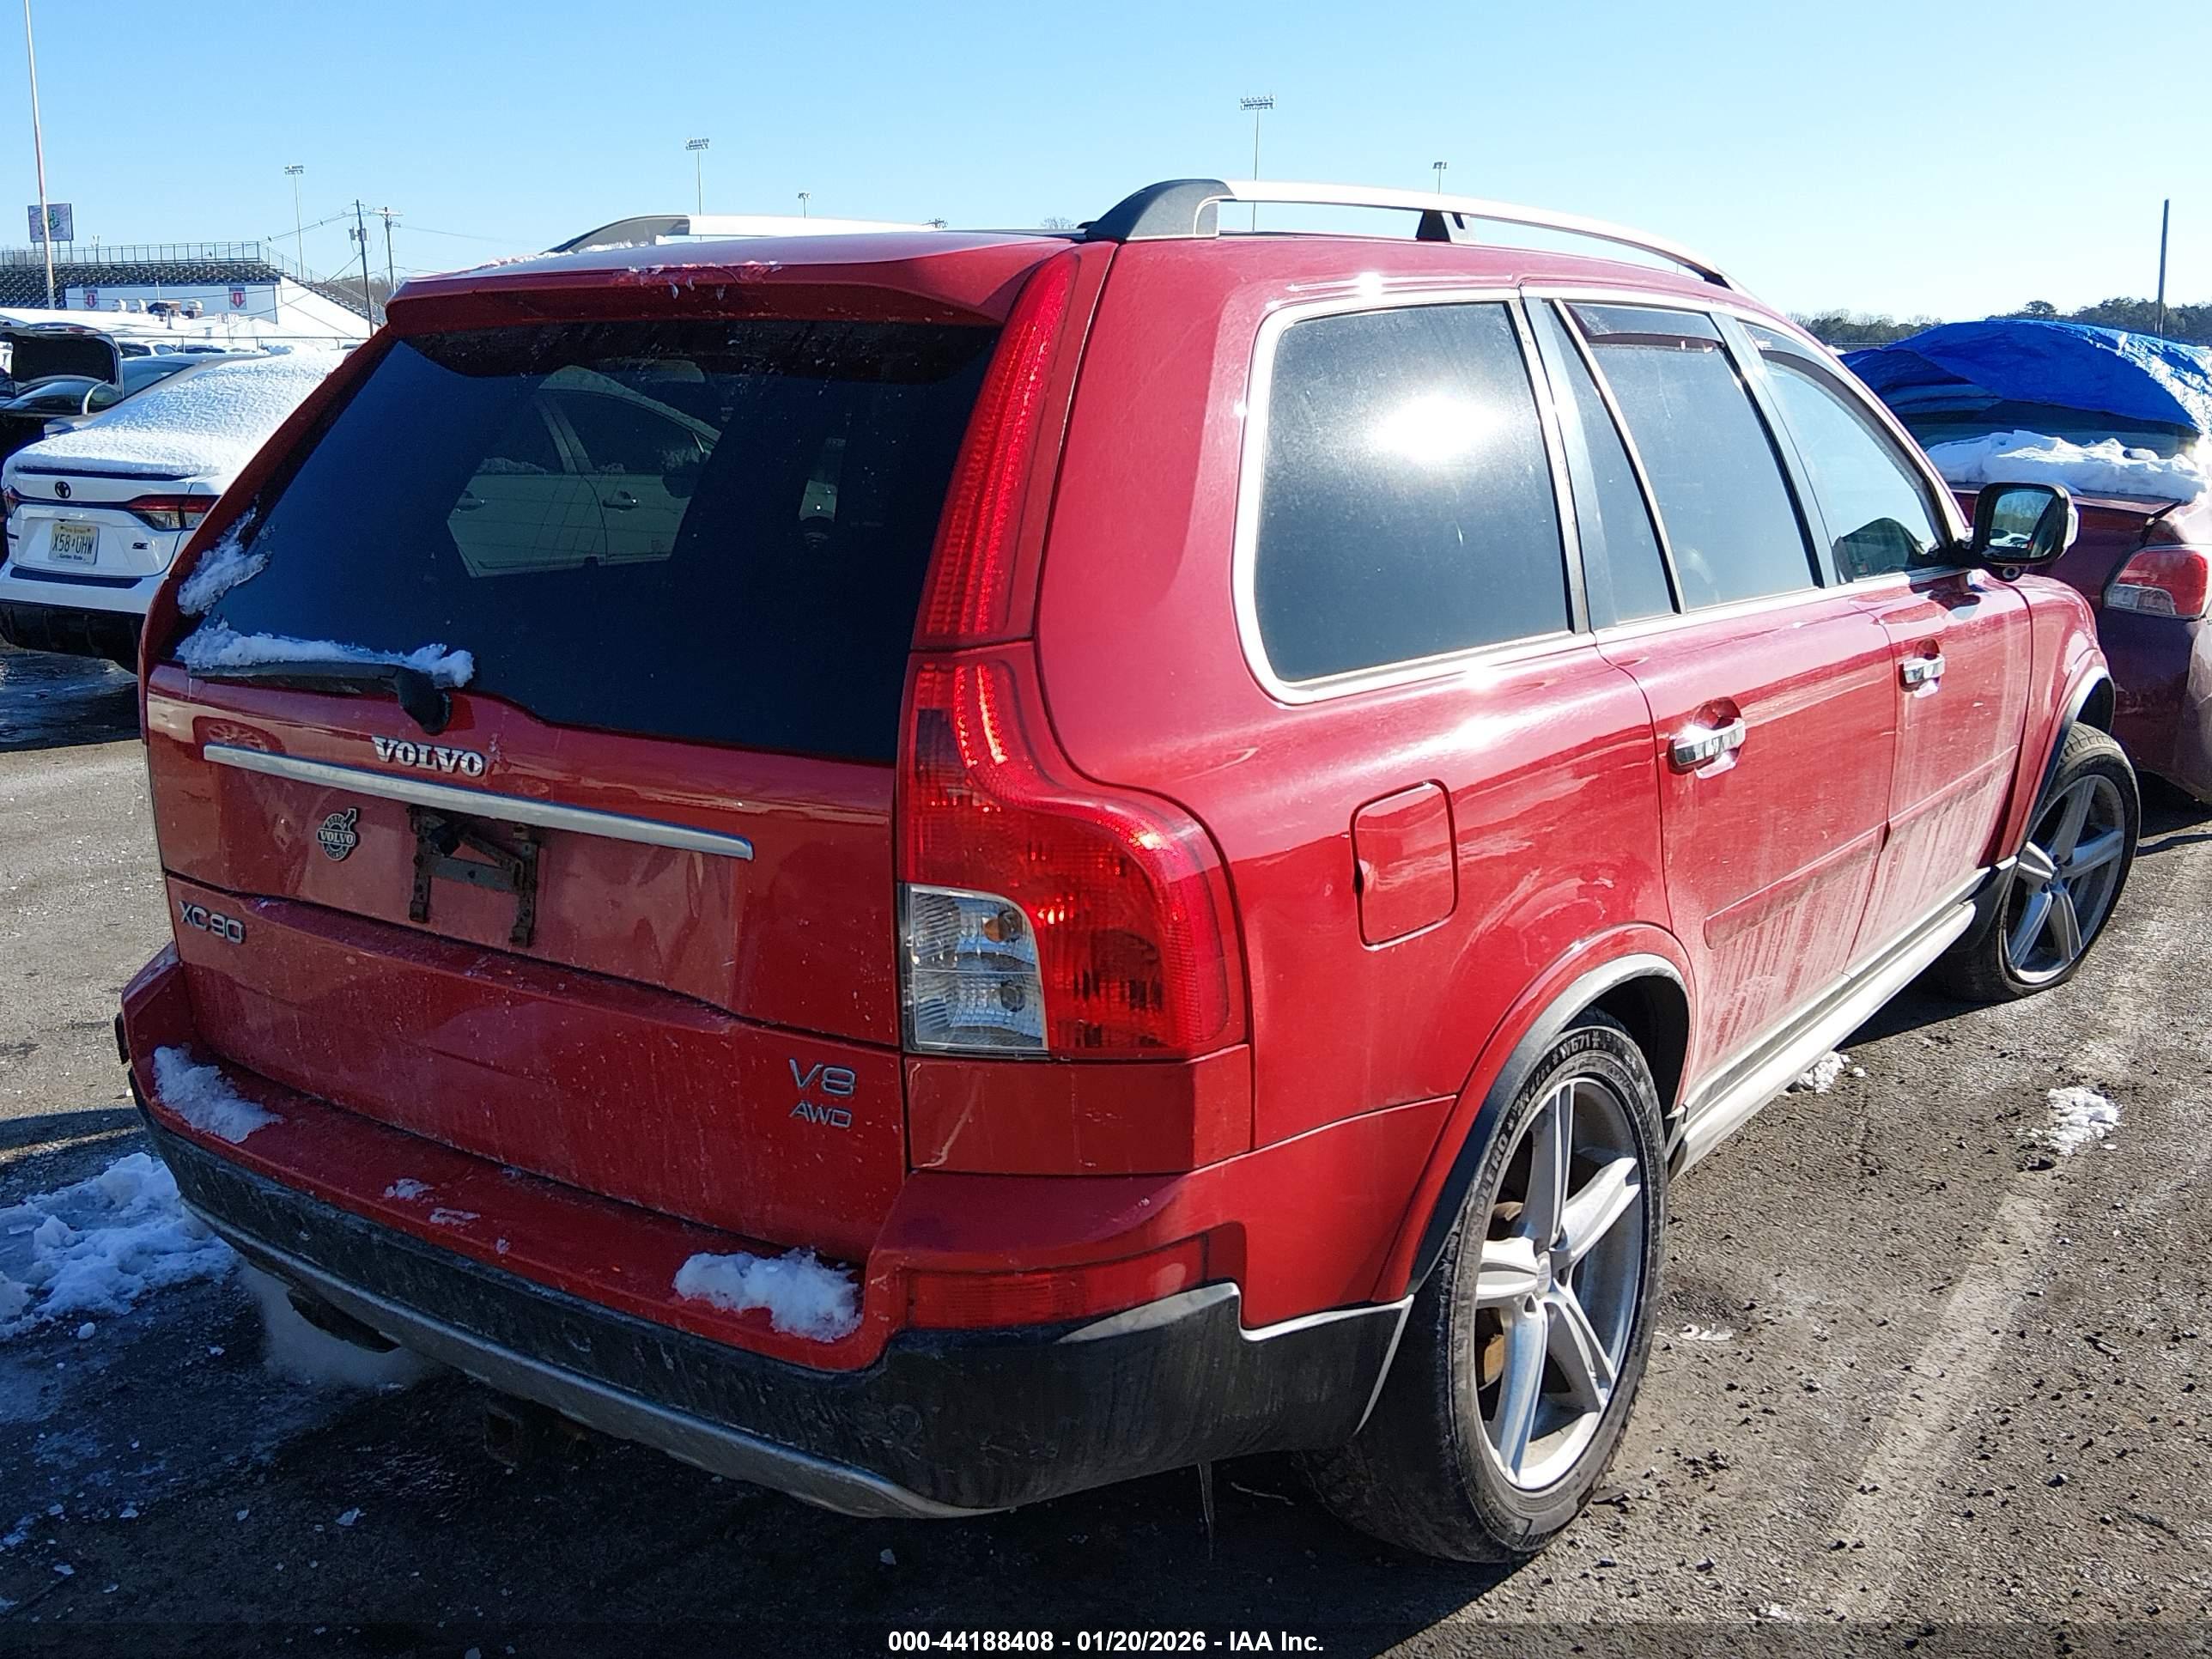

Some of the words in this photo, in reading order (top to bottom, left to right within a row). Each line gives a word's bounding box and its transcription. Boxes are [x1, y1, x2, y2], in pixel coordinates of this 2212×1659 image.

[372, 736, 483, 777] VOLVO
[319, 830, 354, 844] VOLVO
[179, 901, 244, 944] XC90
[788, 1058, 856, 1097] V8
[788, 1100, 853, 1128] AWD
